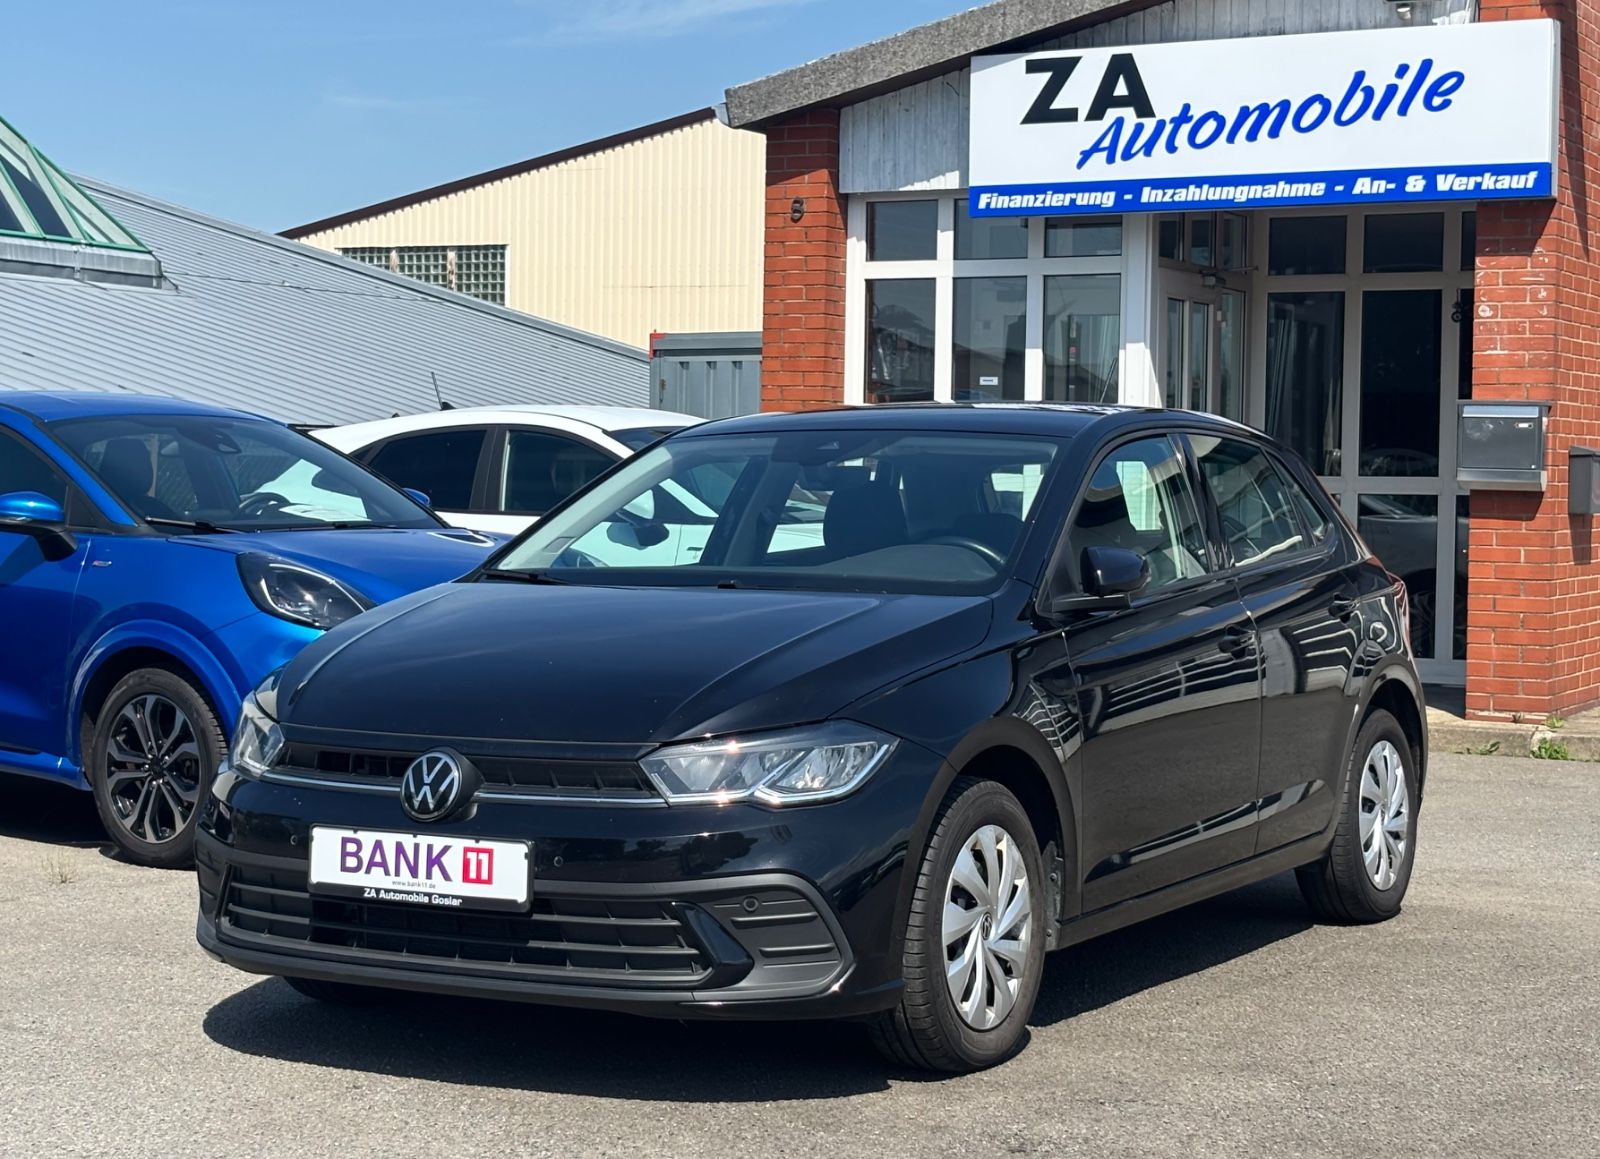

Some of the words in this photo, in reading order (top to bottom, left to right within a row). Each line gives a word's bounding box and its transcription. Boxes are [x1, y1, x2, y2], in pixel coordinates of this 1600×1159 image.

[1020, 52, 1156, 125] ZA
[1076, 58, 1465, 170] Automobile
[978, 190, 1116, 210] Finanzierung
[1140, 180, 1326, 203] Inzahlungnahme
[1352, 176, 1397, 195] An-
[1405, 174, 1427, 193] &
[1436, 170, 1539, 192] Verkauf
[340, 836, 453, 882] BANK
[465, 850, 492, 882] 11
[363, 887, 377, 898] ZA
[379, 889, 429, 903] Automobile
[431, 894, 463, 906] Goslar
